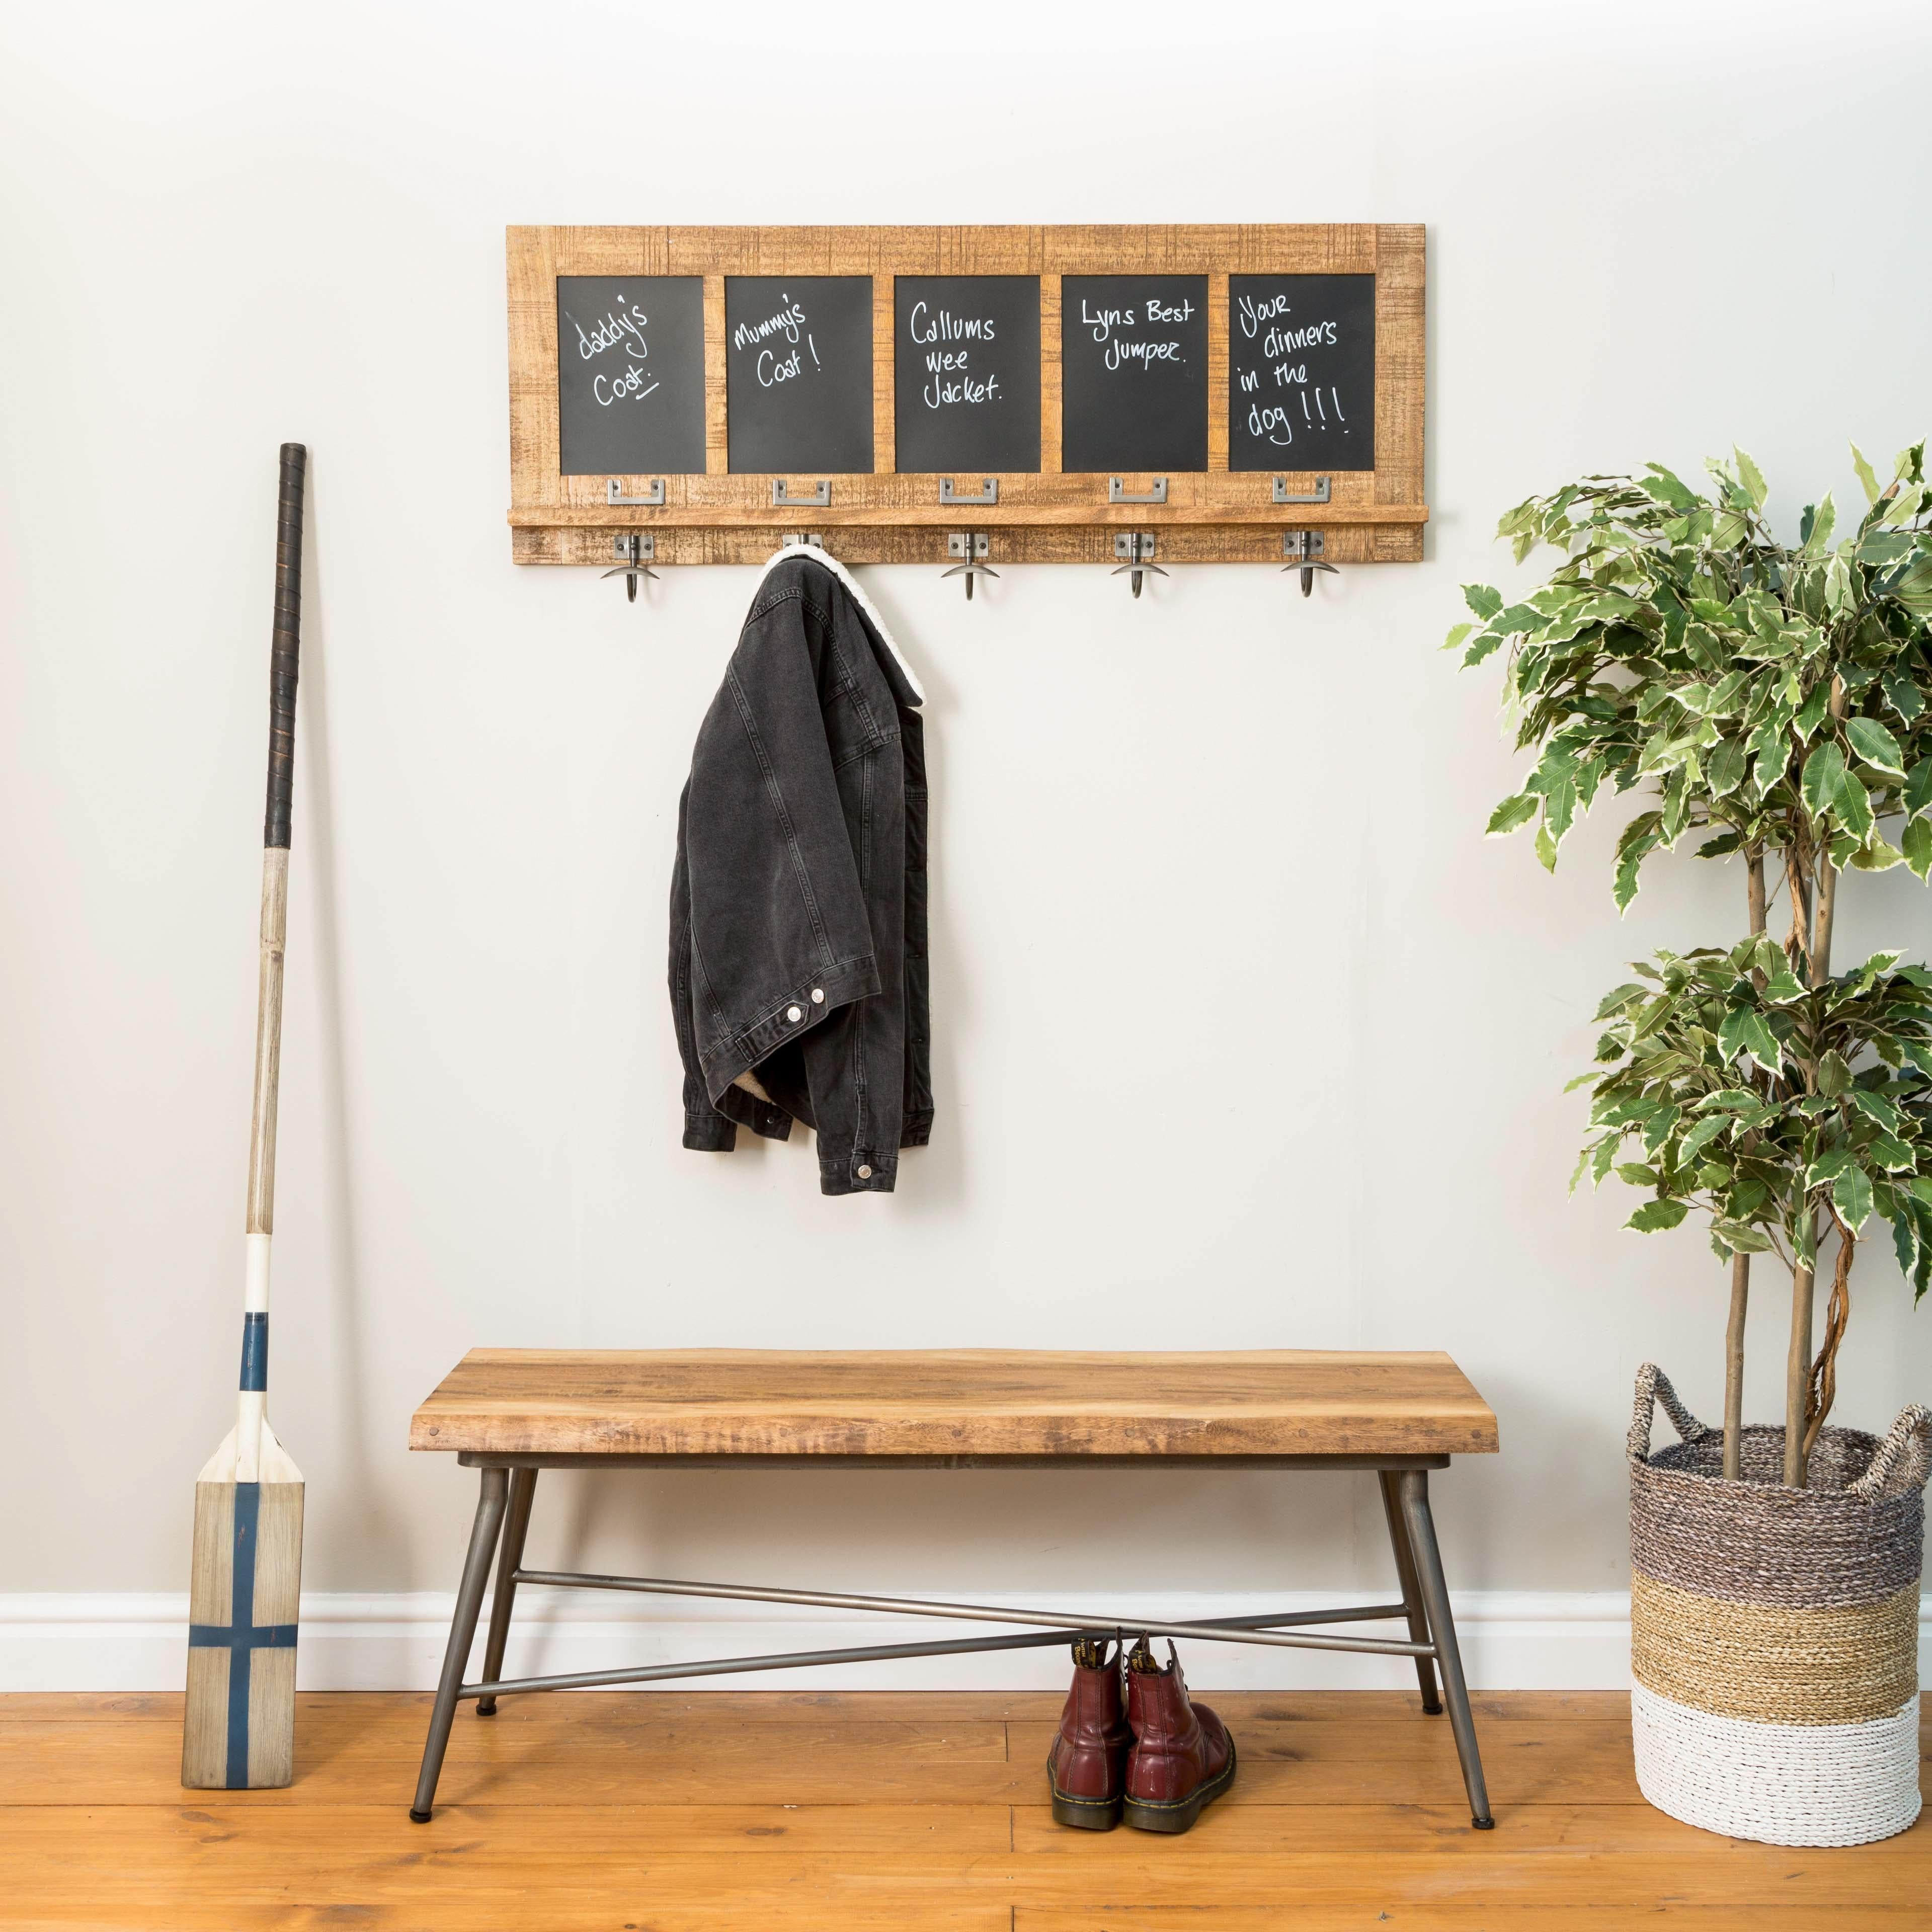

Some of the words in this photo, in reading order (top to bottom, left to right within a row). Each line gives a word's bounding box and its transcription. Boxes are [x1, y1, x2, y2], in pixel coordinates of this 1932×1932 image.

[733, 293, 806, 351] Mummy's
[911, 301, 995, 344] Callums
[1082, 299, 1135, 342] Lyns
[1146, 298, 1195, 323] Best
[1264, 321, 1337, 358] dinners
[1237, 367, 1259, 392] in
[1273, 362, 1308, 386] the
